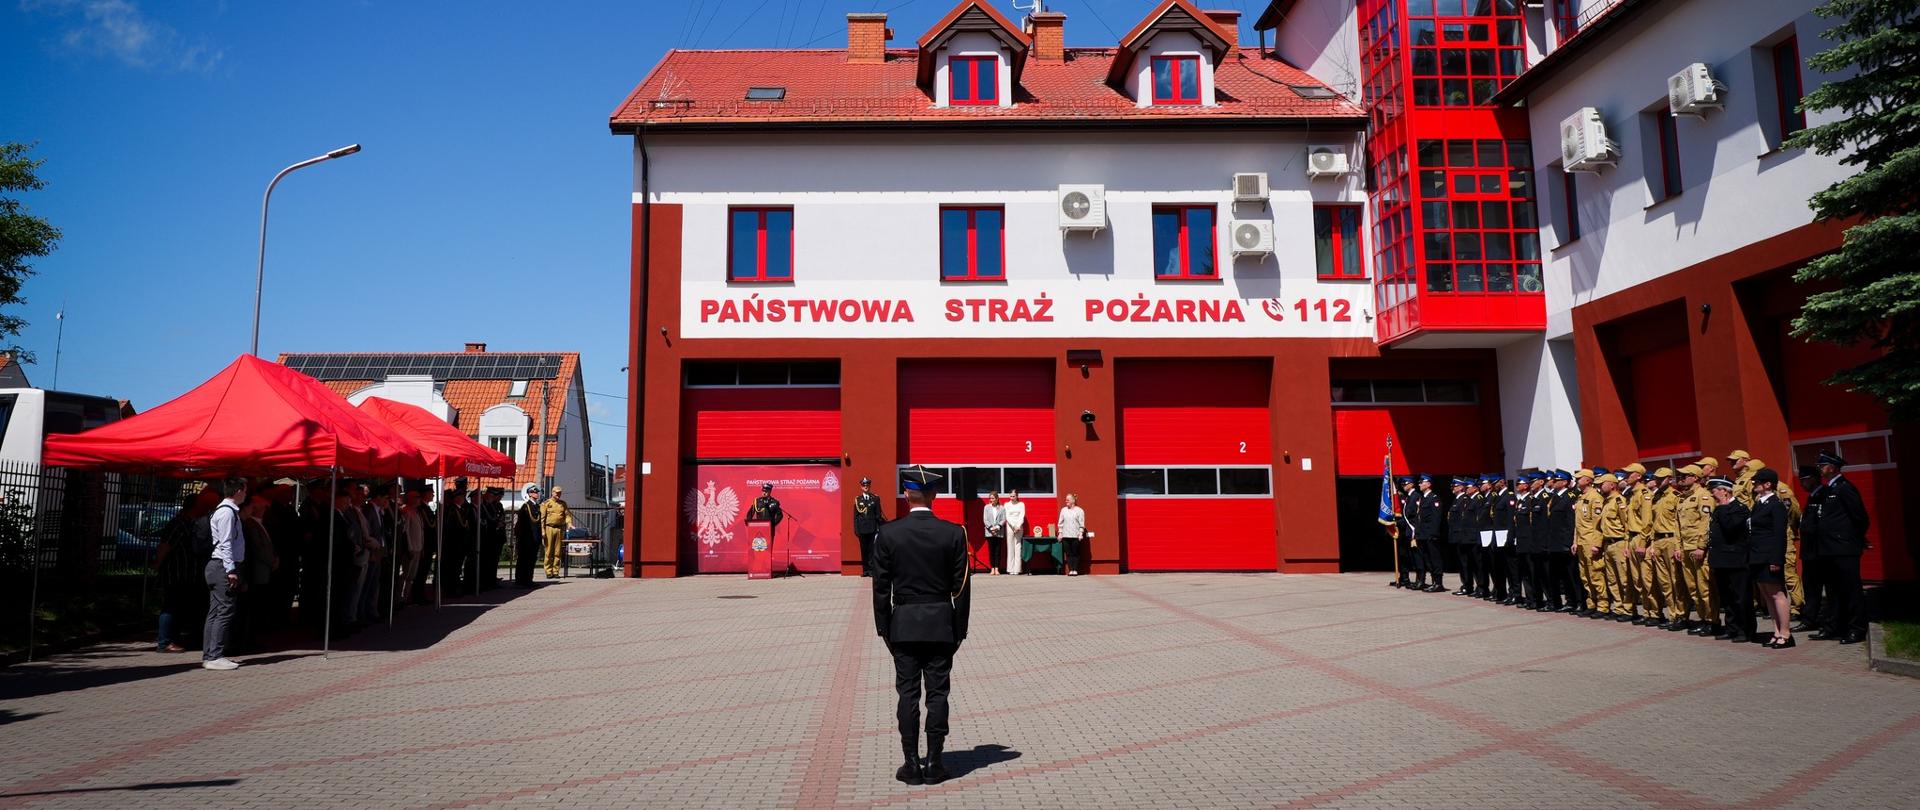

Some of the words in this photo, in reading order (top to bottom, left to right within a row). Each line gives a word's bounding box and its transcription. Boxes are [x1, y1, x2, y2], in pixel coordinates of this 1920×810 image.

[700, 291, 914, 323] PAŃSTWOWA
[944, 291, 1055, 323] STRAŻ
[1084, 291, 1245, 323] POŻARNA
[1293, 298, 1352, 322] 112
[1025, 440, 1032, 453] 3
[1239, 441, 1247, 453] 2
